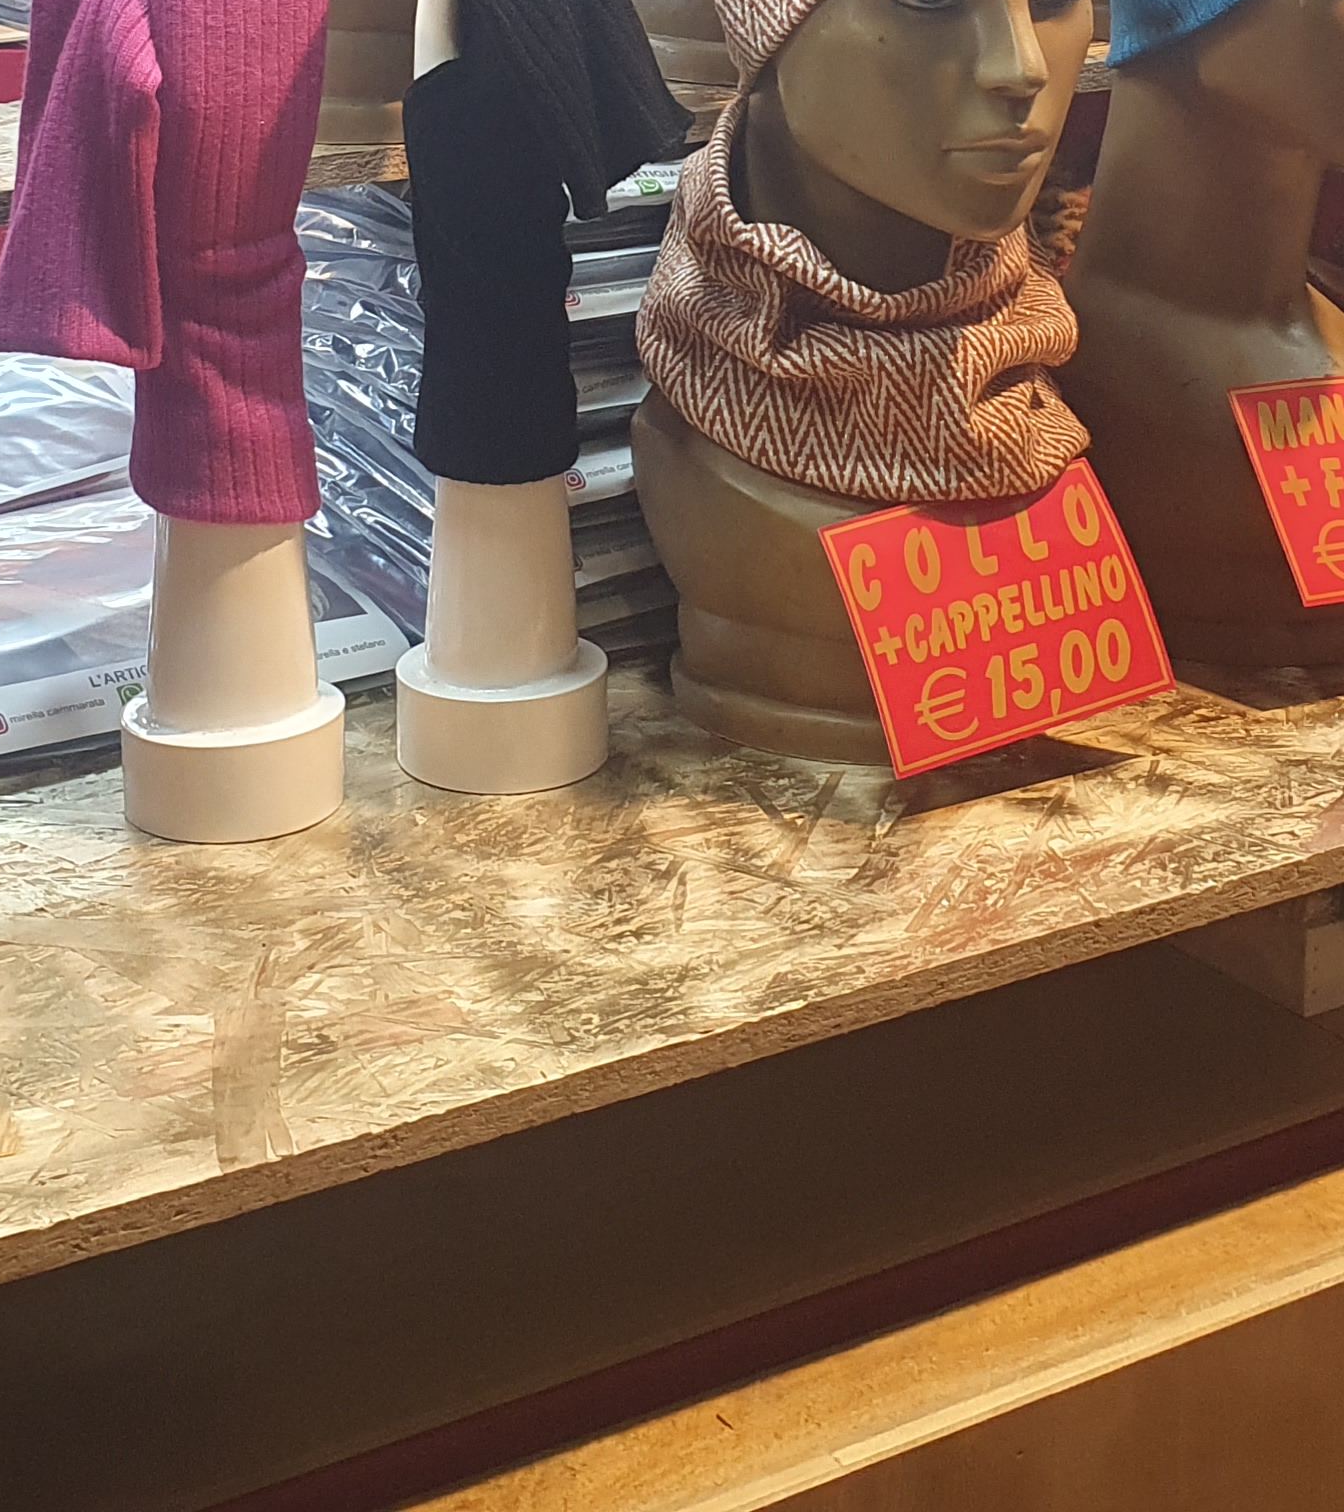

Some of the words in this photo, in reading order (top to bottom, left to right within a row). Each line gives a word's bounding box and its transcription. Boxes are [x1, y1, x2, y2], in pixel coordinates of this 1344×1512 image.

[847, 482, 1102, 612] COLLO
[872, 553, 1128, 666] +CAPPELLINO
[985, 617, 1132, 718] 15,00
